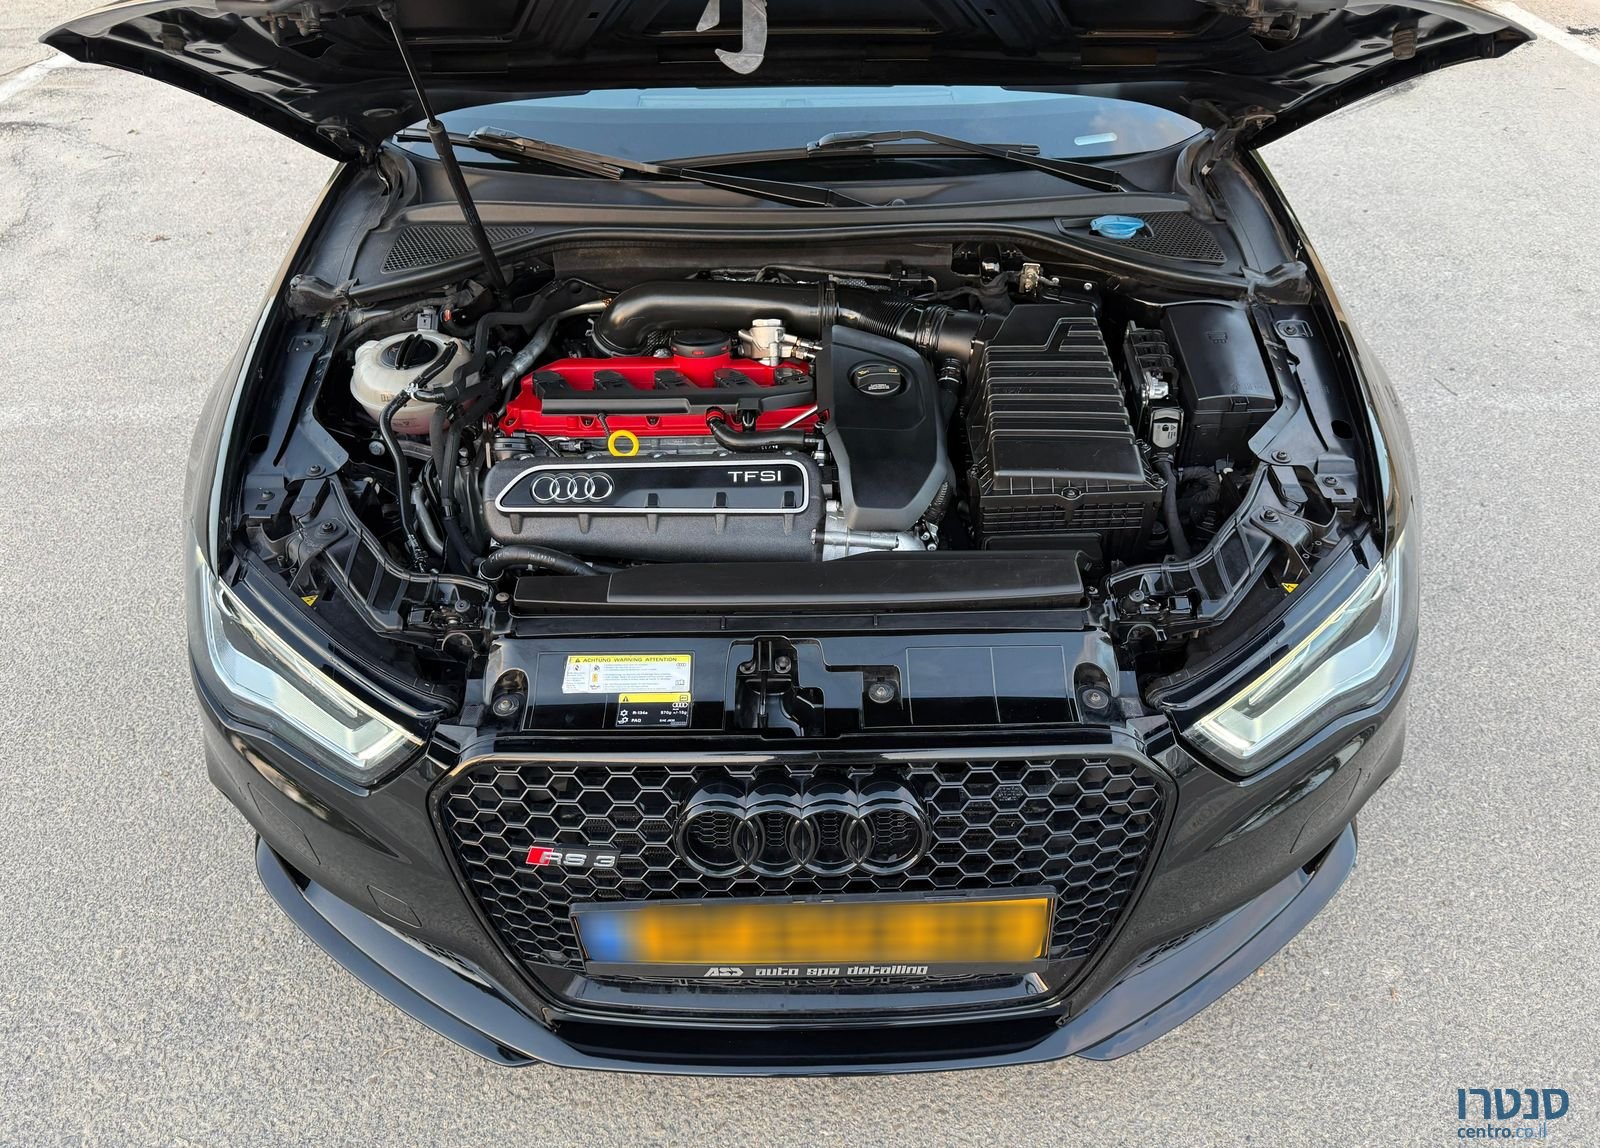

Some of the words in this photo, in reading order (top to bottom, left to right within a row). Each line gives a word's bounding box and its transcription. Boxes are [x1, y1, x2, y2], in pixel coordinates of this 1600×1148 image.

[728, 470, 782, 482] TFSI
[540, 852, 588, 866] RS
[593, 855, 616, 867] 3
[755, 967, 800, 976] auto
[806, 967, 840, 976] spa
[847, 965, 929, 975] detailing
